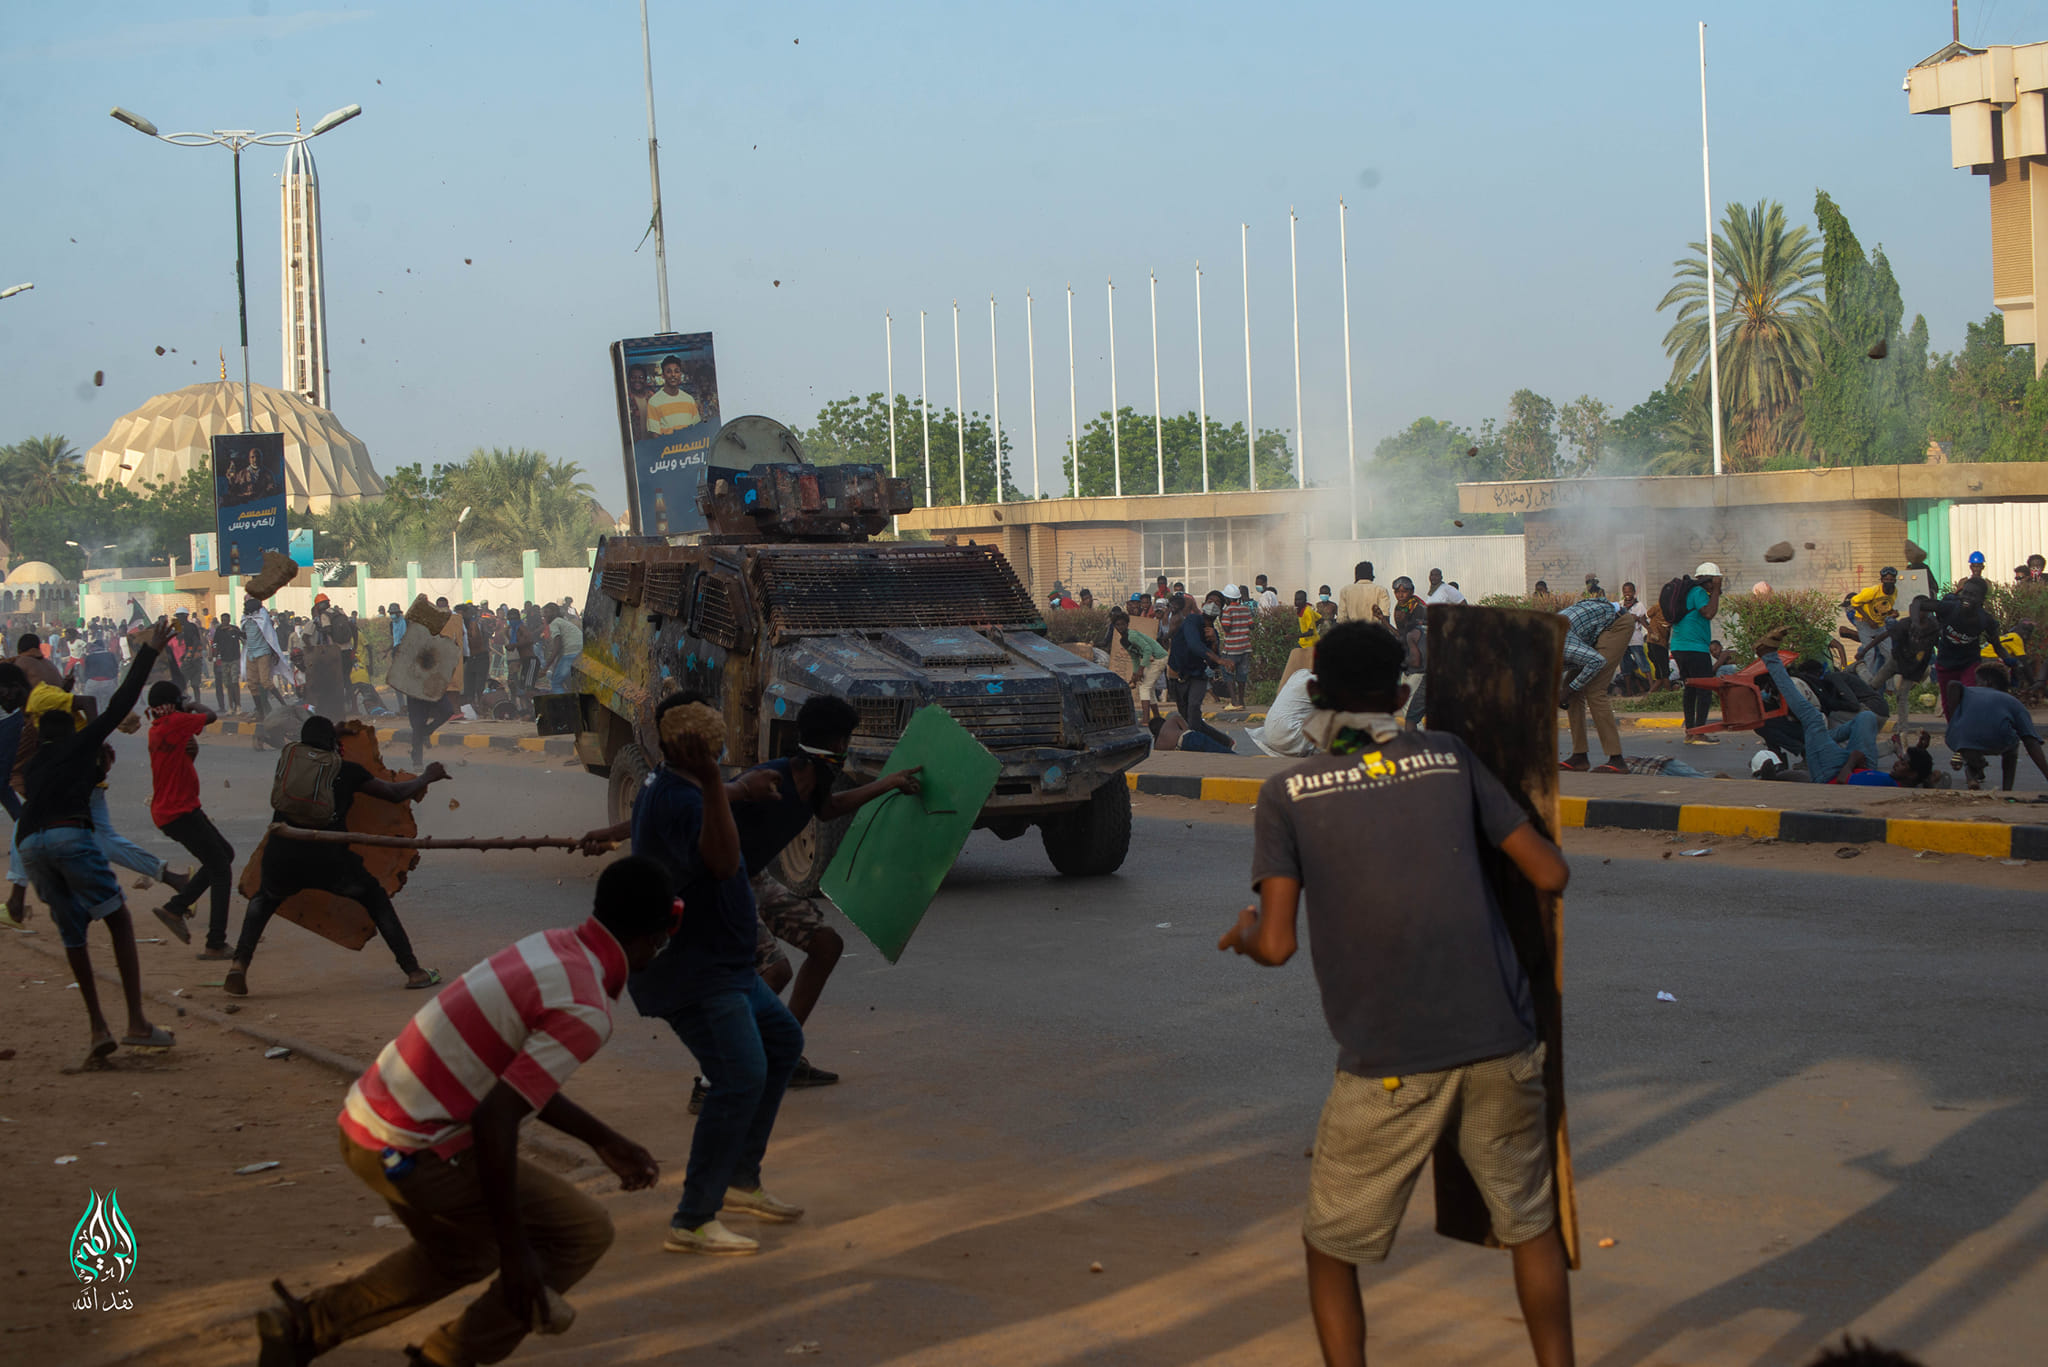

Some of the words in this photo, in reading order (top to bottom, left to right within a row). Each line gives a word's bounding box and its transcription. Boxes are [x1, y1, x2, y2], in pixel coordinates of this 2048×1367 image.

[661, 437, 709, 458] السمسم
[650, 459, 677, 473] وبس
[238, 507, 276, 520] السمسم
[228, 521, 250, 531] وبس
[251, 516, 276, 529] زاكي
